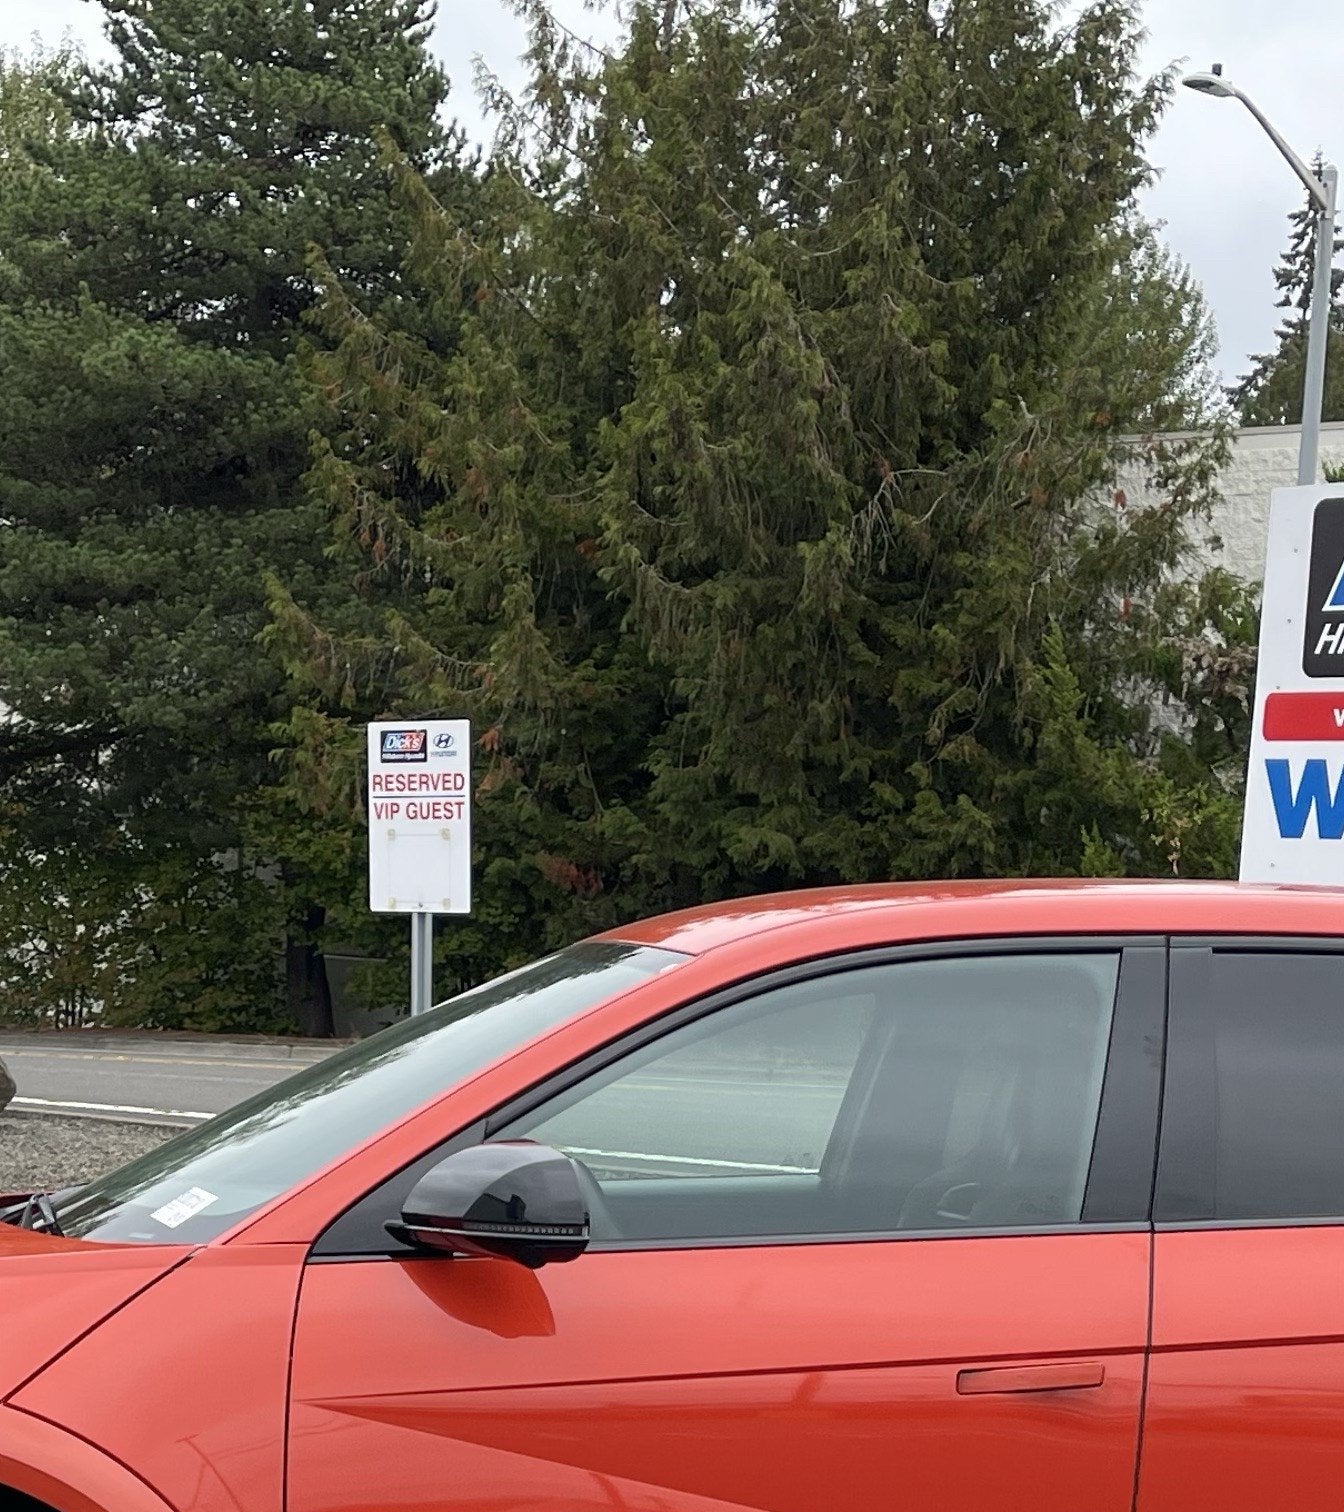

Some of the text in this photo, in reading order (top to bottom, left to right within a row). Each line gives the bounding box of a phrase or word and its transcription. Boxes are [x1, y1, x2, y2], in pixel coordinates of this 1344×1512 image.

[372, 773, 465, 792] RESERVED
[373, 802, 465, 820] VIP GUEST
